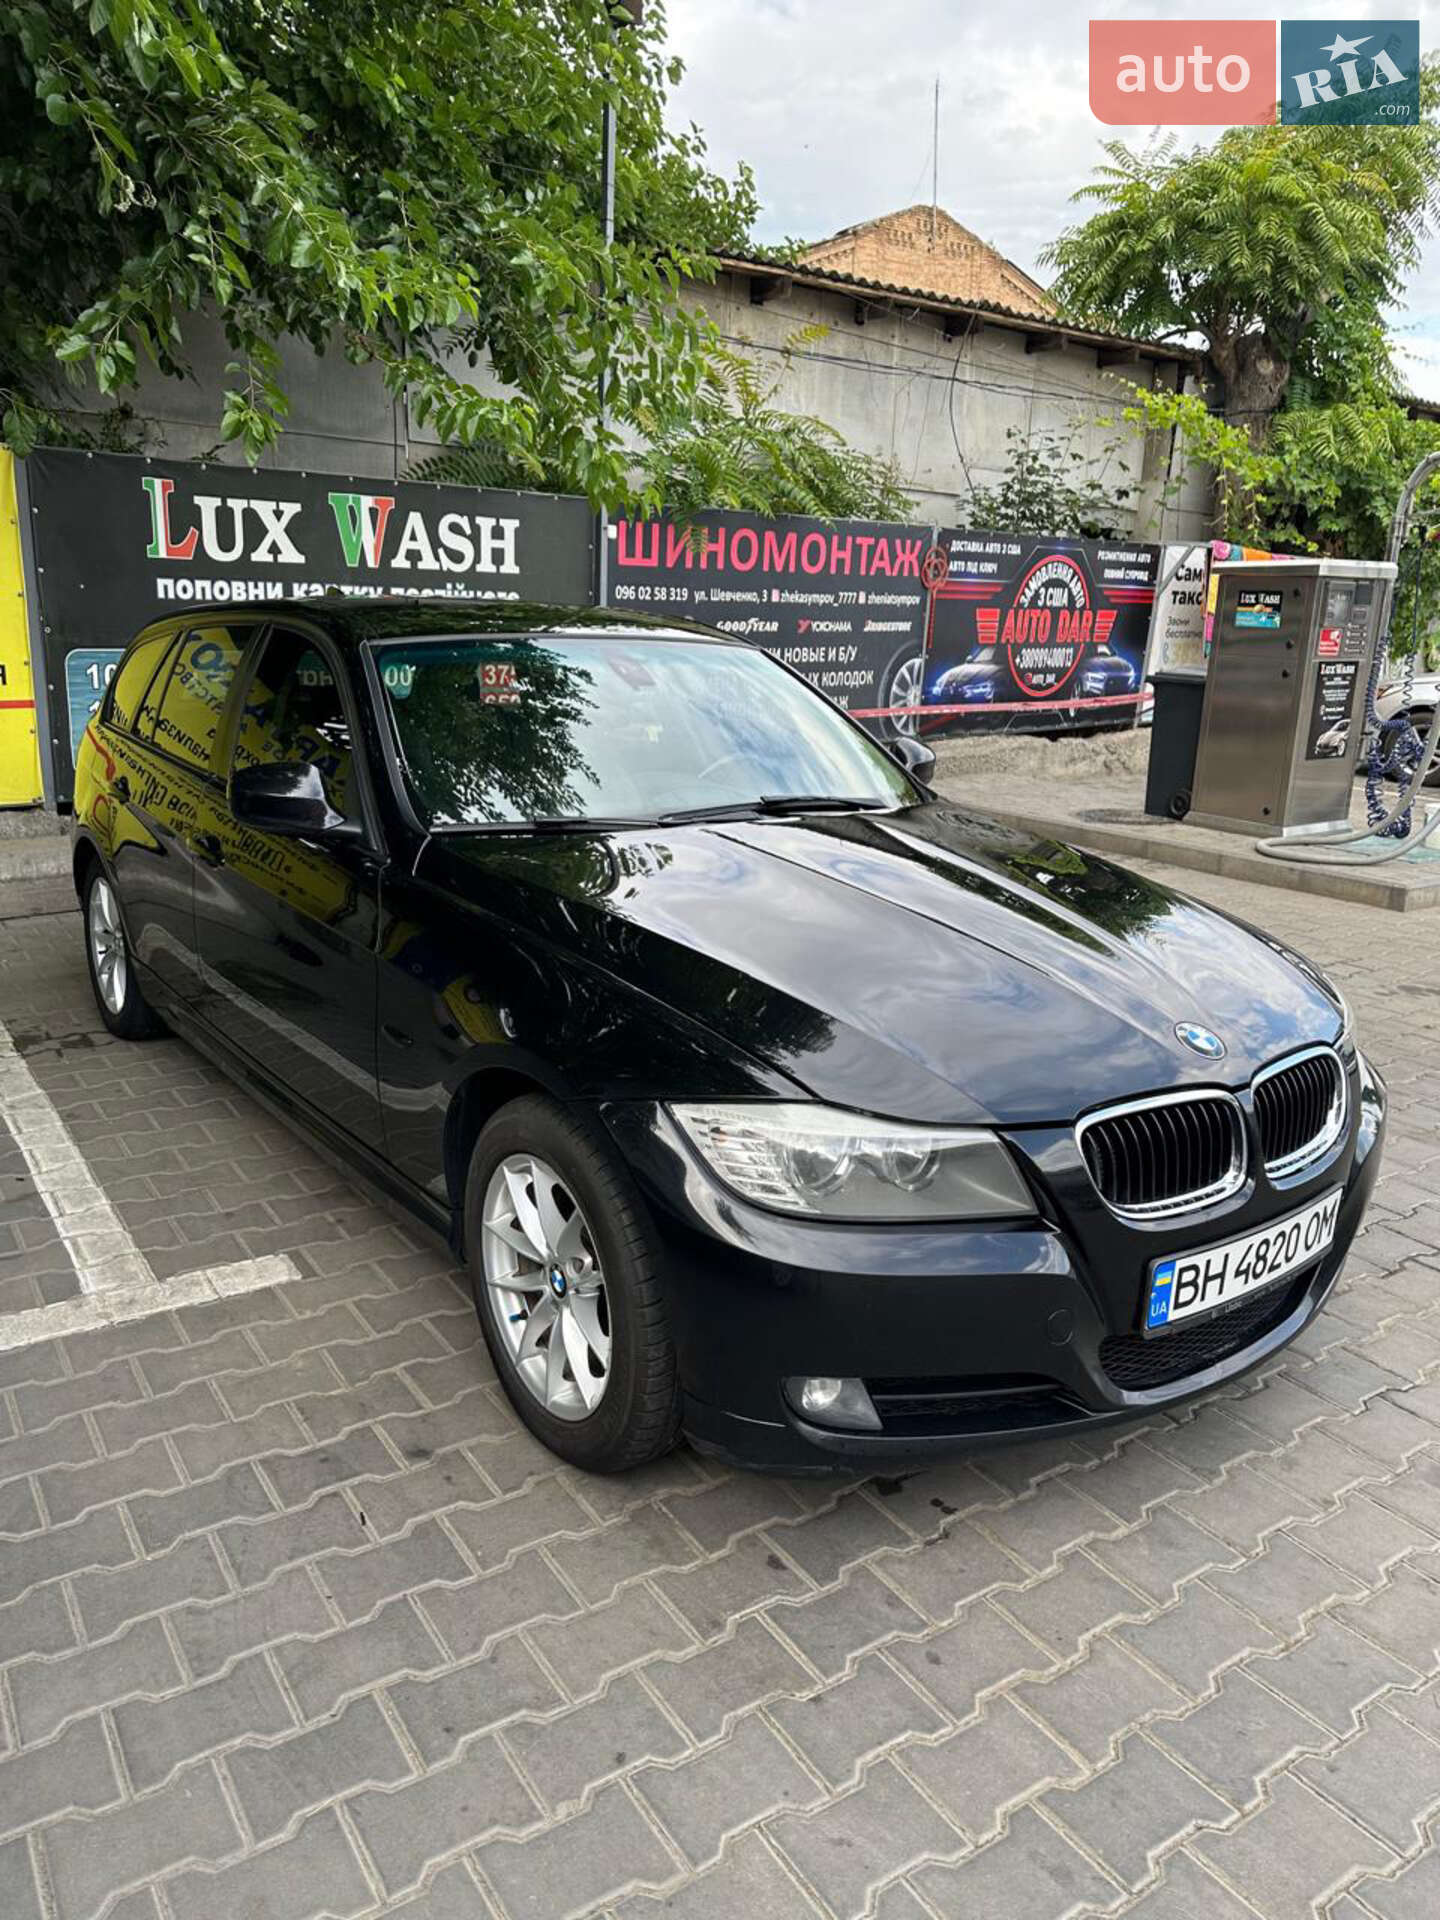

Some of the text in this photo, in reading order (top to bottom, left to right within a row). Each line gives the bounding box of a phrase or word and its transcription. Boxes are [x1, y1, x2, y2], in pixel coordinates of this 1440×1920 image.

[141, 477, 520, 574] LUX WASH
[617, 519, 922, 577] ШИНОМОНТАЖ
[1007, 543, 1021, 553] США
[949, 560, 966, 571] АВТО
[155, 577, 283, 601] поповни
[615, 585, 635, 600] 096
[638, 586, 651, 600] 02
[653, 586, 668, 600] 58
[669, 587, 688, 601] 319
[710, 589, 760, 604] Шевченко,
[762, 590, 768, 602] 3
[1046, 587, 1069, 608] США
[717, 618, 779, 634] GOODYEAR
[811, 621, 852, 633] YOKOHAMA
[1001, 608, 1093, 644] AUTO DAR
[784, 646, 825, 663] НОВЫЕ
[827, 646, 836, 662] И
[838, 645, 858, 665] Б/У
[821, 669, 874, 688] КОЛОДОК
[1173, 1200, 1337, 1310] BH 4820 OM
[1150, 1301, 1169, 1317] UA
